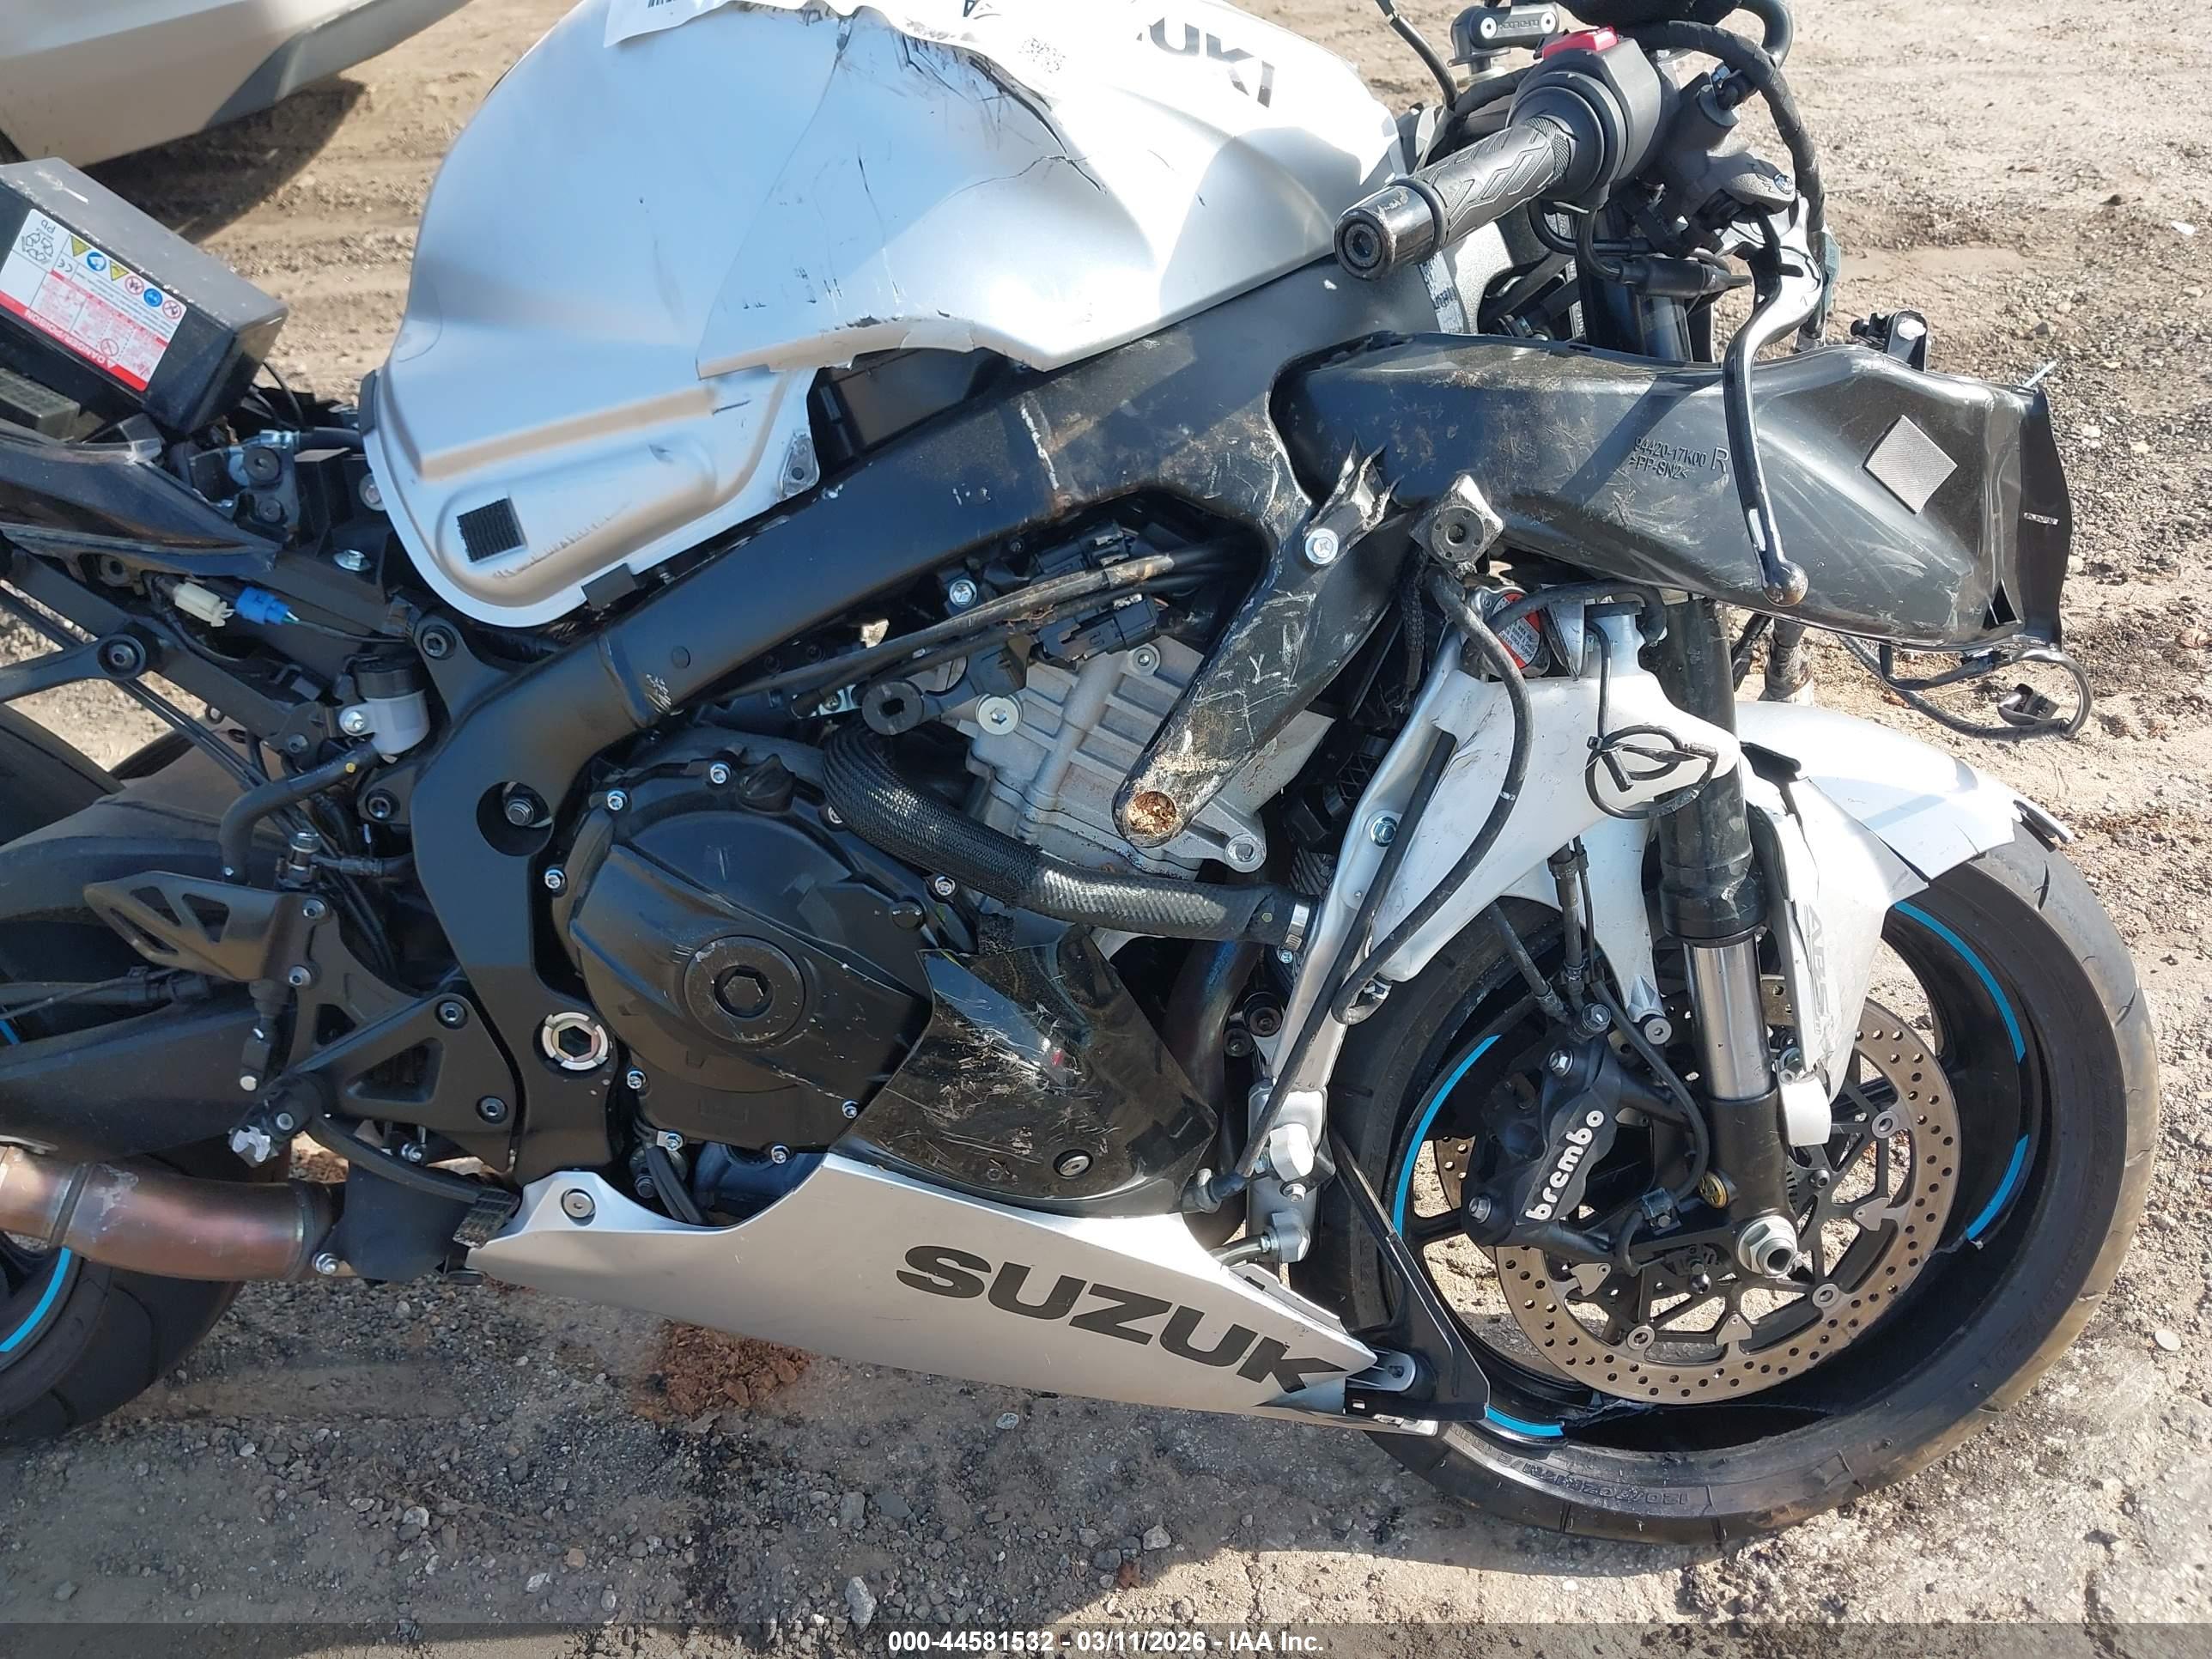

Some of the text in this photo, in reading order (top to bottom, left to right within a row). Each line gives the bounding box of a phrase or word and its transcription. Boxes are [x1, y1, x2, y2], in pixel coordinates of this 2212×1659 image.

[40, 218, 57, 234] Pb
[24, 309, 106, 364] DANGER/POISON
[1711, 446, 1729, 474] R
[1524, 1109, 1605, 1221] brembo
